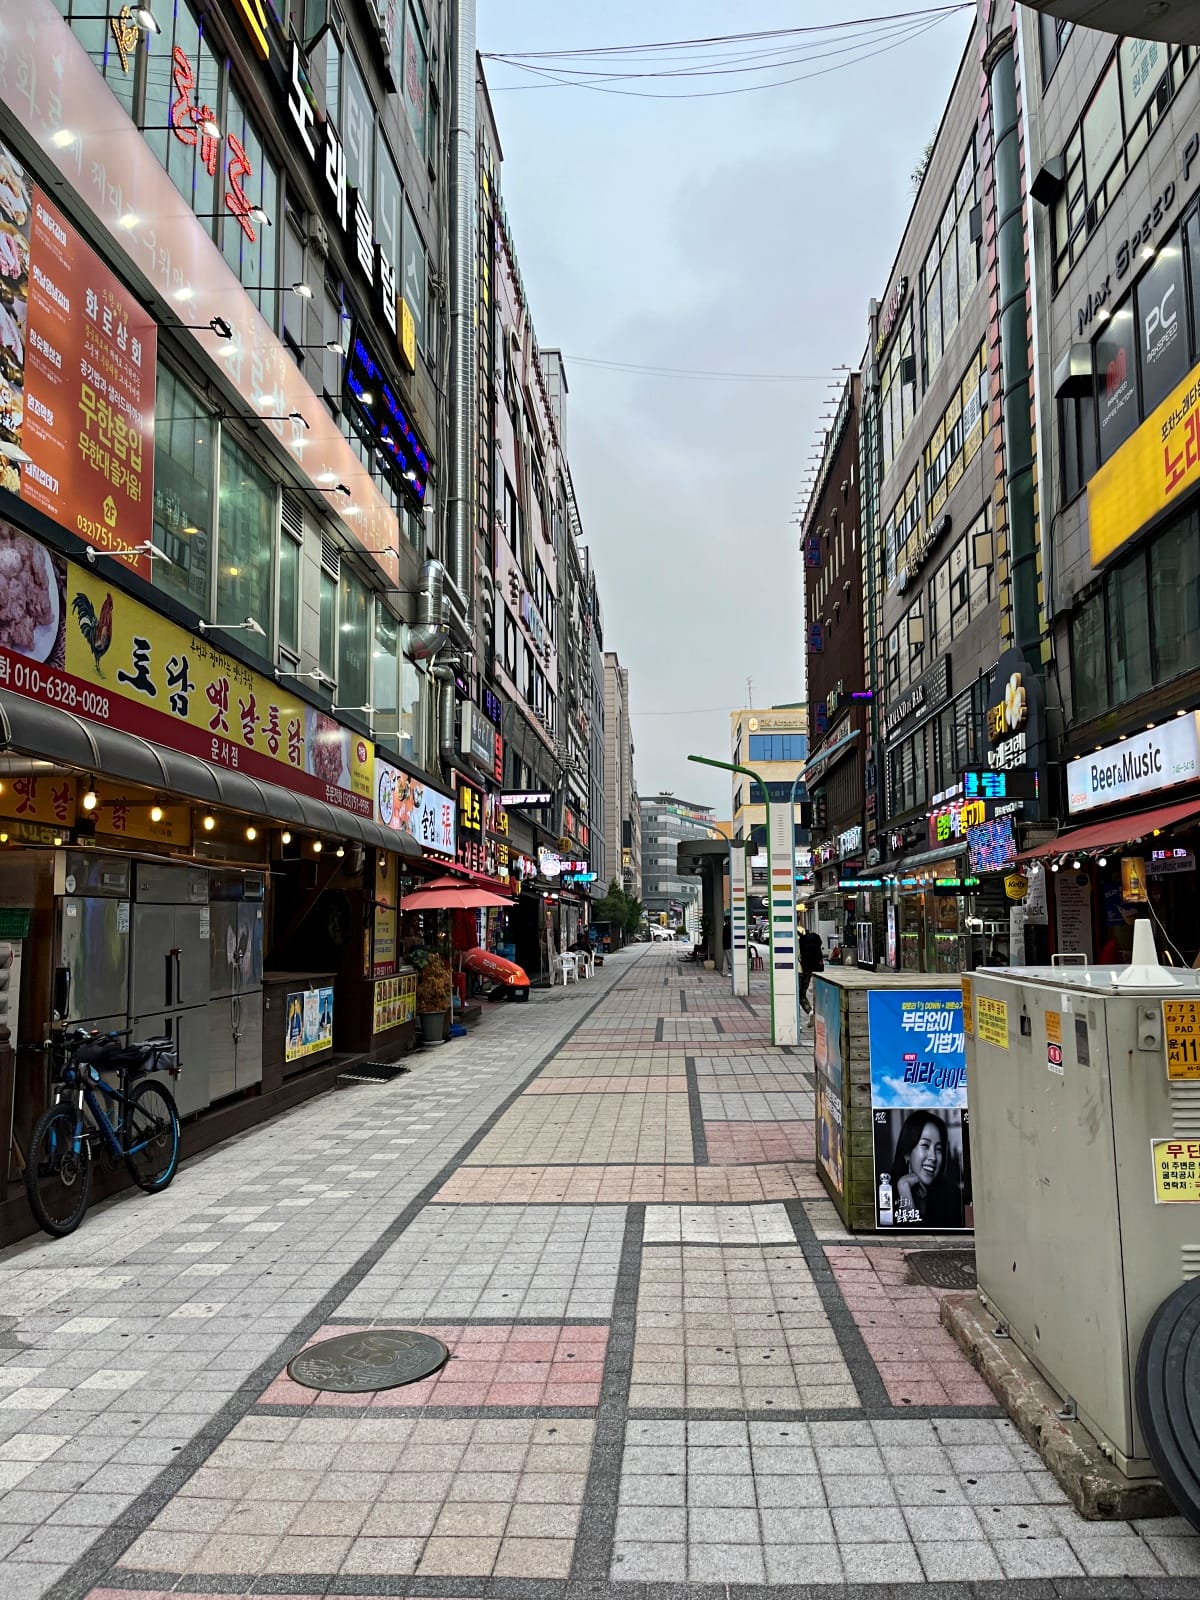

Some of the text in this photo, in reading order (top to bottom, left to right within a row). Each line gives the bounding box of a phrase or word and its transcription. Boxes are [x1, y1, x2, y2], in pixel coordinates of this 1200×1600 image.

[288, 40, 397, 336] 노래클럽
[1115, 181, 1175, 281] SPEED
[1182, 132, 1200, 182] P
[36, 203, 67, 247] 숯불닭갈비
[86, 288, 142, 368] 화로상회
[1145, 283, 1177, 350] PC
[80, 358, 107, 396] 공깃밥과
[79, 383, 142, 473] 무한흡입
[78, 431, 110, 480] 무한대
[110, 458, 142, 503] 즐거움!
[105, 502, 115, 521] 2F
[14, 670, 110, 720] 010-6328-0028
[117, 636, 196, 718] 토닭
[205, 677, 305, 767] 옛날통닭
[210, 738, 239, 768] 운서점
[1090, 742, 1162, 793] Beer&Music
[12, 775, 74, 821] 옛날
[421, 804, 436, 843] 술집
[1008, 880, 1025, 891] Kelly
[901, 1011, 954, 1032] 부담없이
[924, 1032, 965, 1054] 가볍게
[903, 1061, 935, 1084] 테라
[1161, 1161, 1196, 1170] 이 주변은
